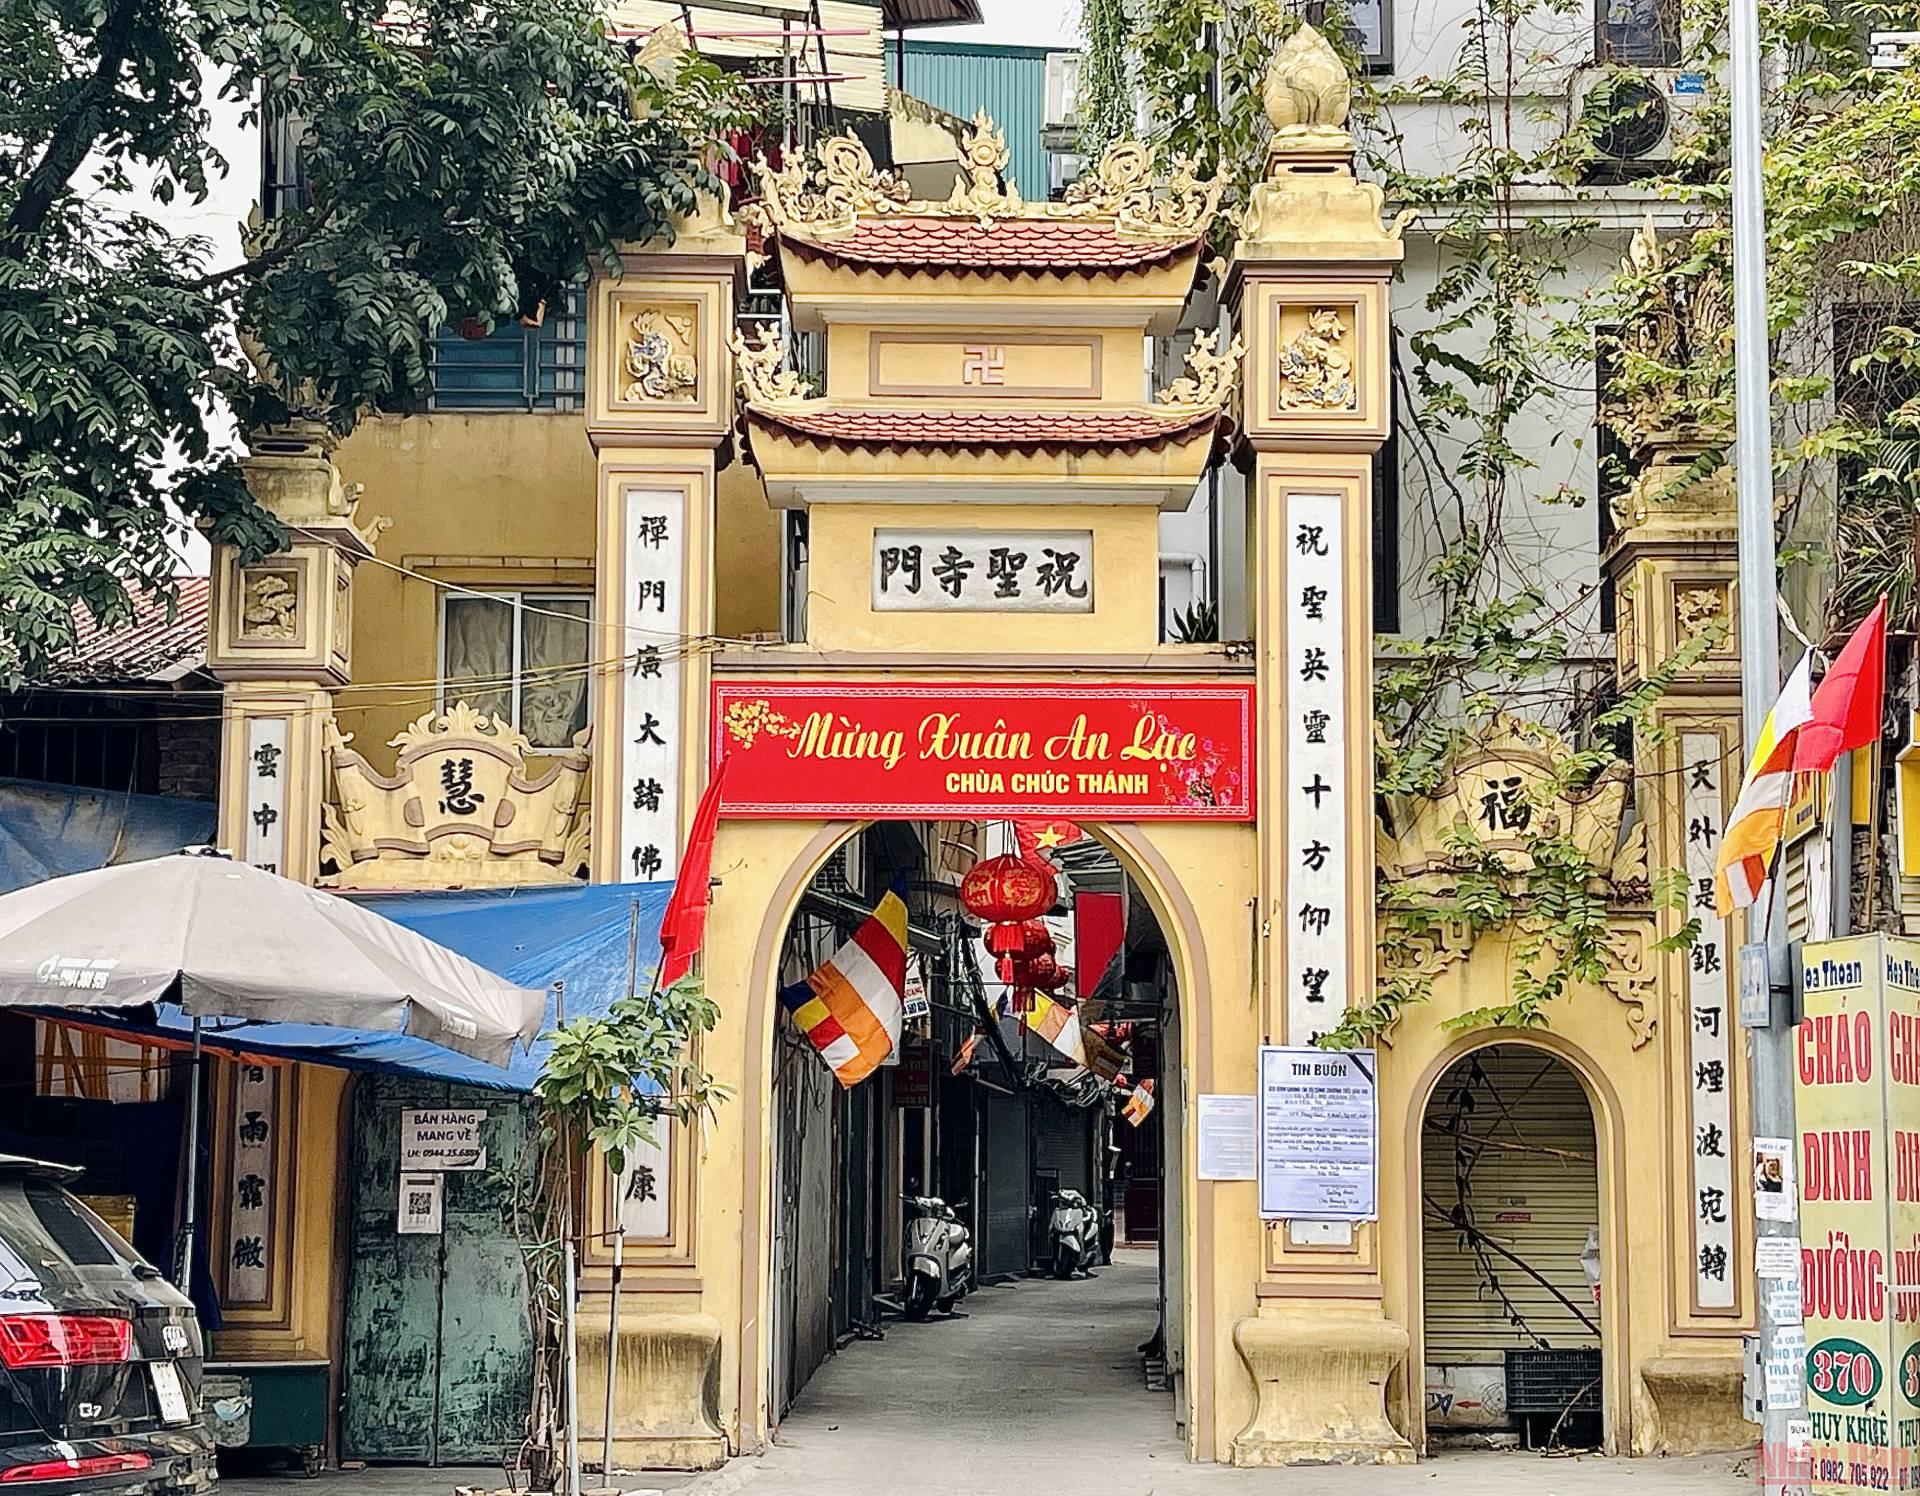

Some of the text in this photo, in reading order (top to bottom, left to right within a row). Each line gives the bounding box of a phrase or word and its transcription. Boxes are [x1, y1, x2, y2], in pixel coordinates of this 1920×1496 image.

[787, 712, 1197, 773] Mừng Xuân An Lạc
[438, 757, 485, 816] 慧
[946, 769, 1149, 794] CHÙA CHÚC THÁNH
[1296, 524, 1331, 1046] 祝聖英靈十方仰望
[1480, 775, 1531, 832] 福
[253, 743, 282, 873] 雲中
[1291, 1063, 1311, 1076] TIN
[414, 1112, 477, 1125] BÁN HÀNG
[416, 1127, 472, 1142] MANG VỀ
[625, 1166, 657, 1203] 康
[1803, 1130, 1872, 1201] DINH
[1801, 1230, 1884, 1322] DƯỠNG
[1813, 1349, 1874, 1396] 370
[1904, 1353, 1920, 1398] 3
[1807, 1411, 1842, 1447] HỤY
[1898, 1418, 1920, 1453] THỤ
[1848, 1462, 1868, 1487] 705
[1870, 1465, 1889, 1491] 922
